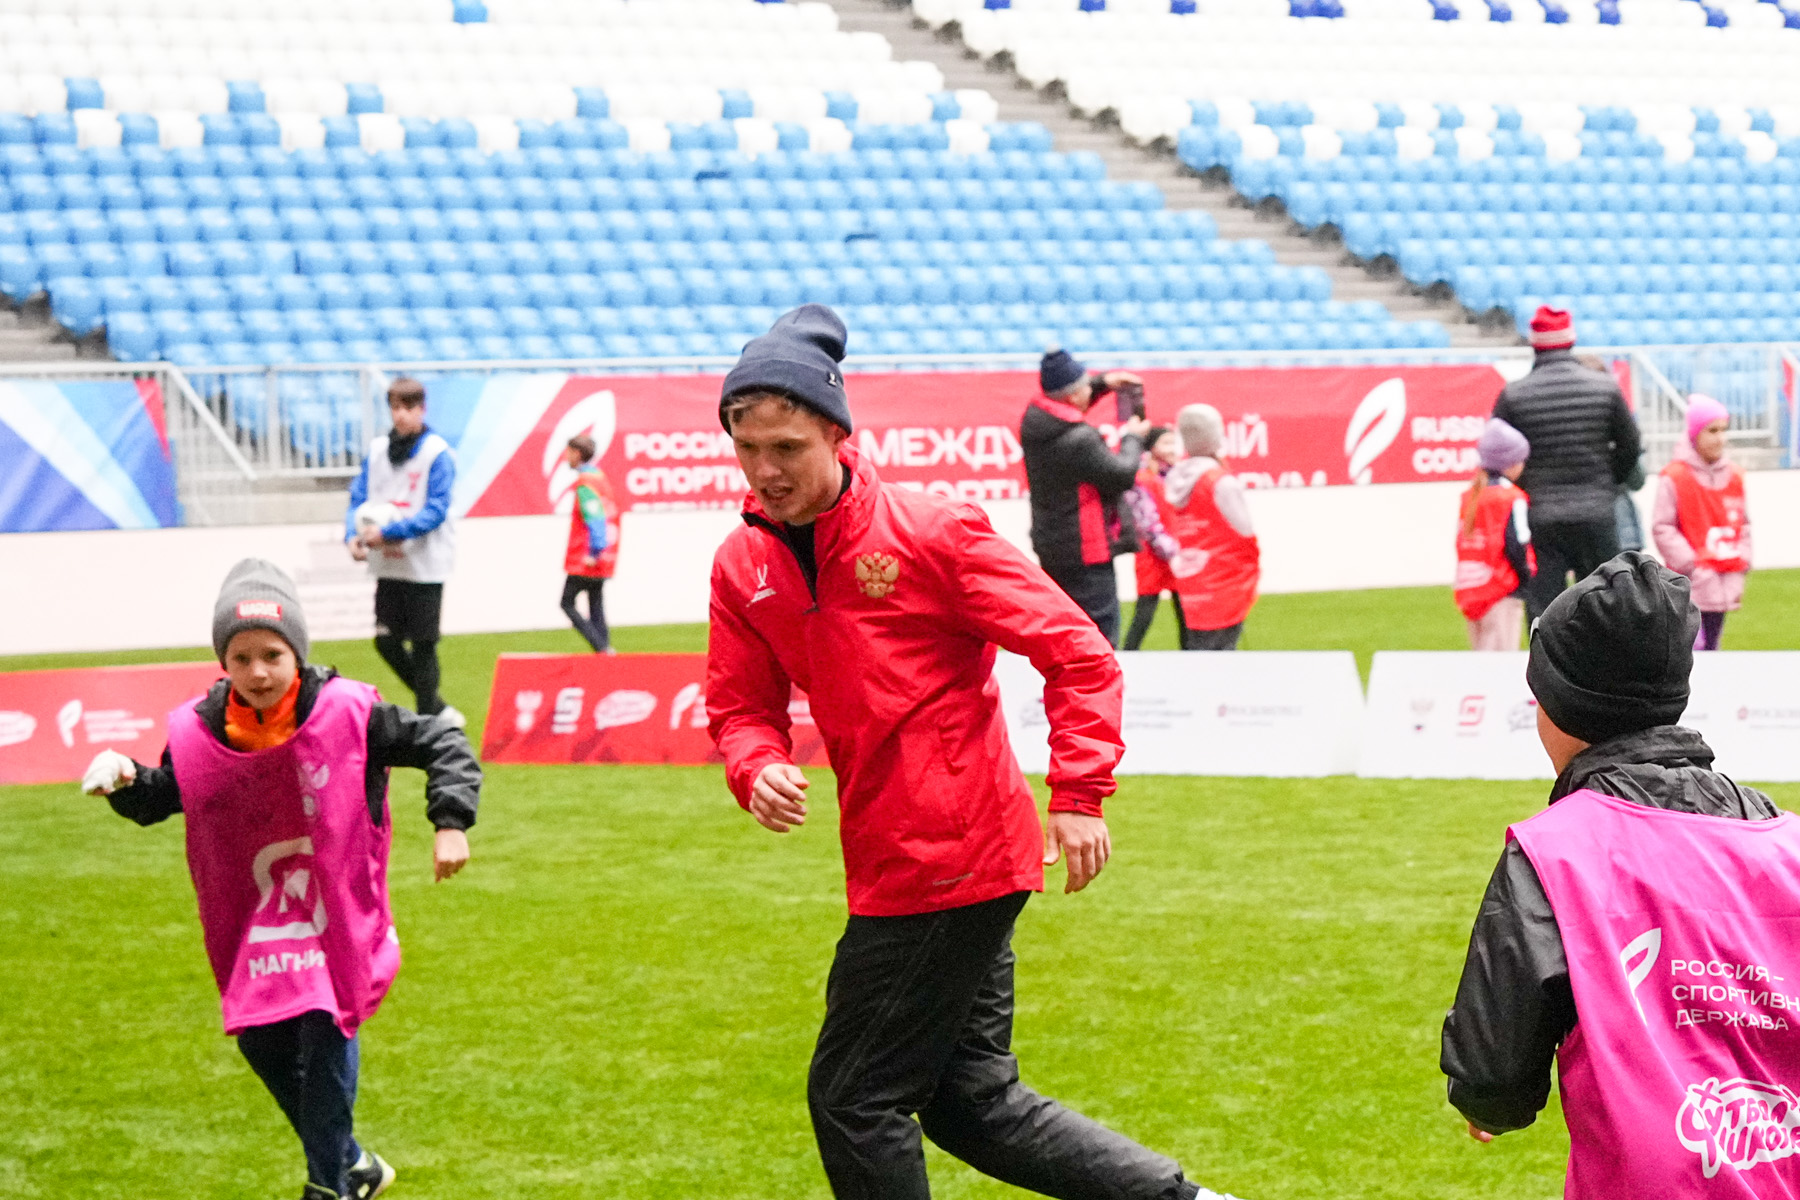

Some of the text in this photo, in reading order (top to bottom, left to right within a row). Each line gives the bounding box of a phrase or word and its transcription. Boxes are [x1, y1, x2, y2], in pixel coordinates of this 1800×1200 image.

[625, 431, 737, 460] РОССИ
[248, 948, 326, 980] МАГНИ
[1675, 1008, 1788, 1031] ДЕРЖАВА
